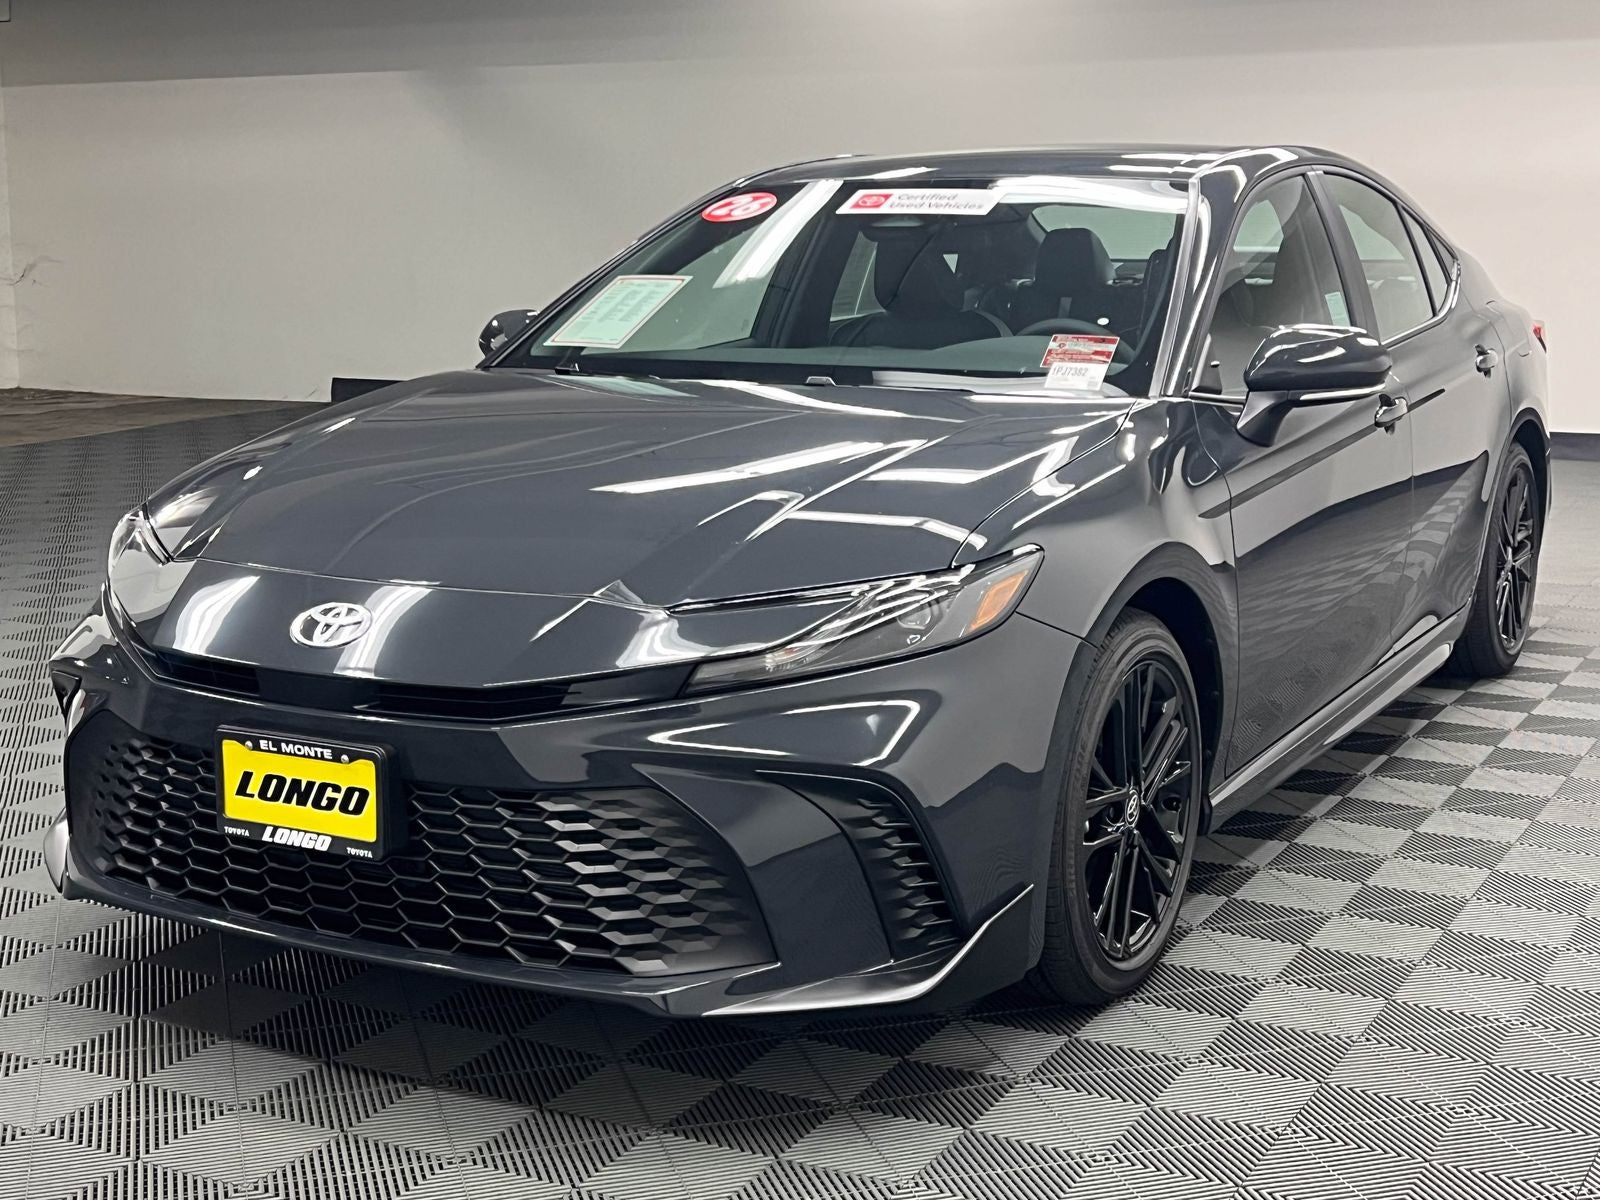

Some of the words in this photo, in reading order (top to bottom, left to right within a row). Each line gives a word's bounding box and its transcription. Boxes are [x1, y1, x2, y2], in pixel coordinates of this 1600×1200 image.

[898, 193, 959, 201] Certified
[709, 197, 773, 217] 26
[890, 201, 924, 209] Used
[928, 201, 985, 210] Vehicles
[259, 739, 278, 751] EL
[281, 742, 333, 760] MONTE
[235, 770, 370, 816] LONGO
[224, 826, 250, 837] TOYOTA
[261, 825, 332, 852] LONGO
[346, 847, 373, 859] TOYOTA
